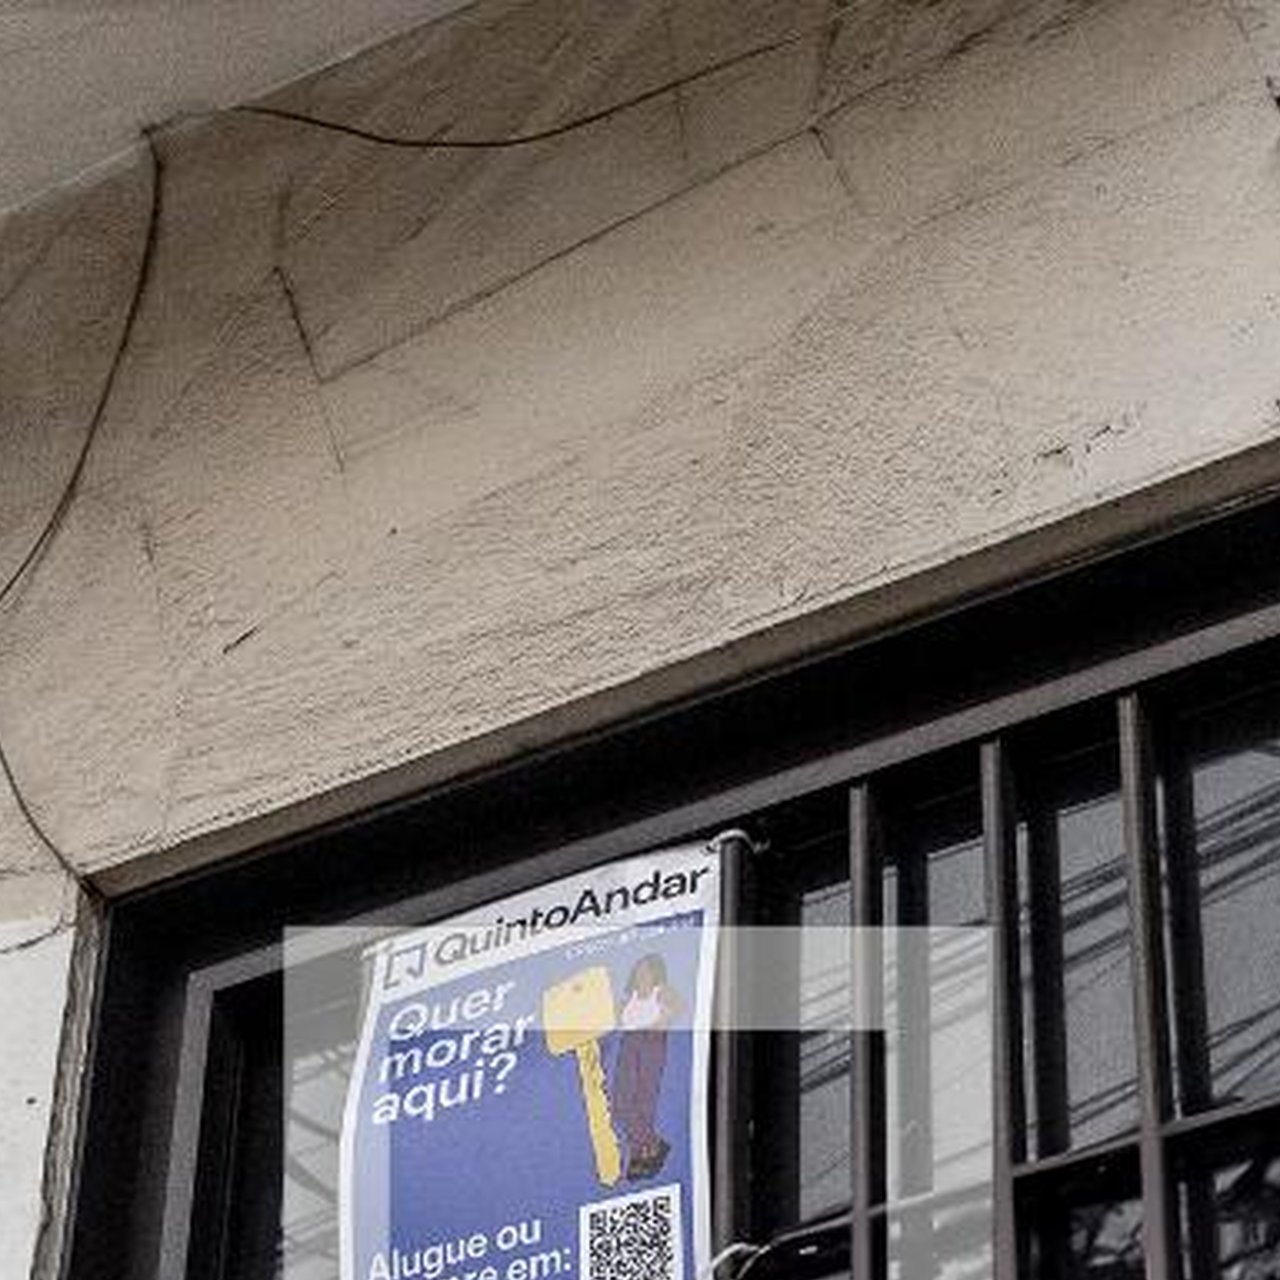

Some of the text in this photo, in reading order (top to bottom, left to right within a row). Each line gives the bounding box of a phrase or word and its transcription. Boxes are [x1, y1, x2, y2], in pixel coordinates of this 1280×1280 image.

[433, 864, 711, 967] QuintoAndar
[388, 980, 515, 1042] Quer
[378, 1013, 535, 1084] morar
[371, 1052, 518, 1125] aqui?
[495, 1219, 542, 1251] ou
